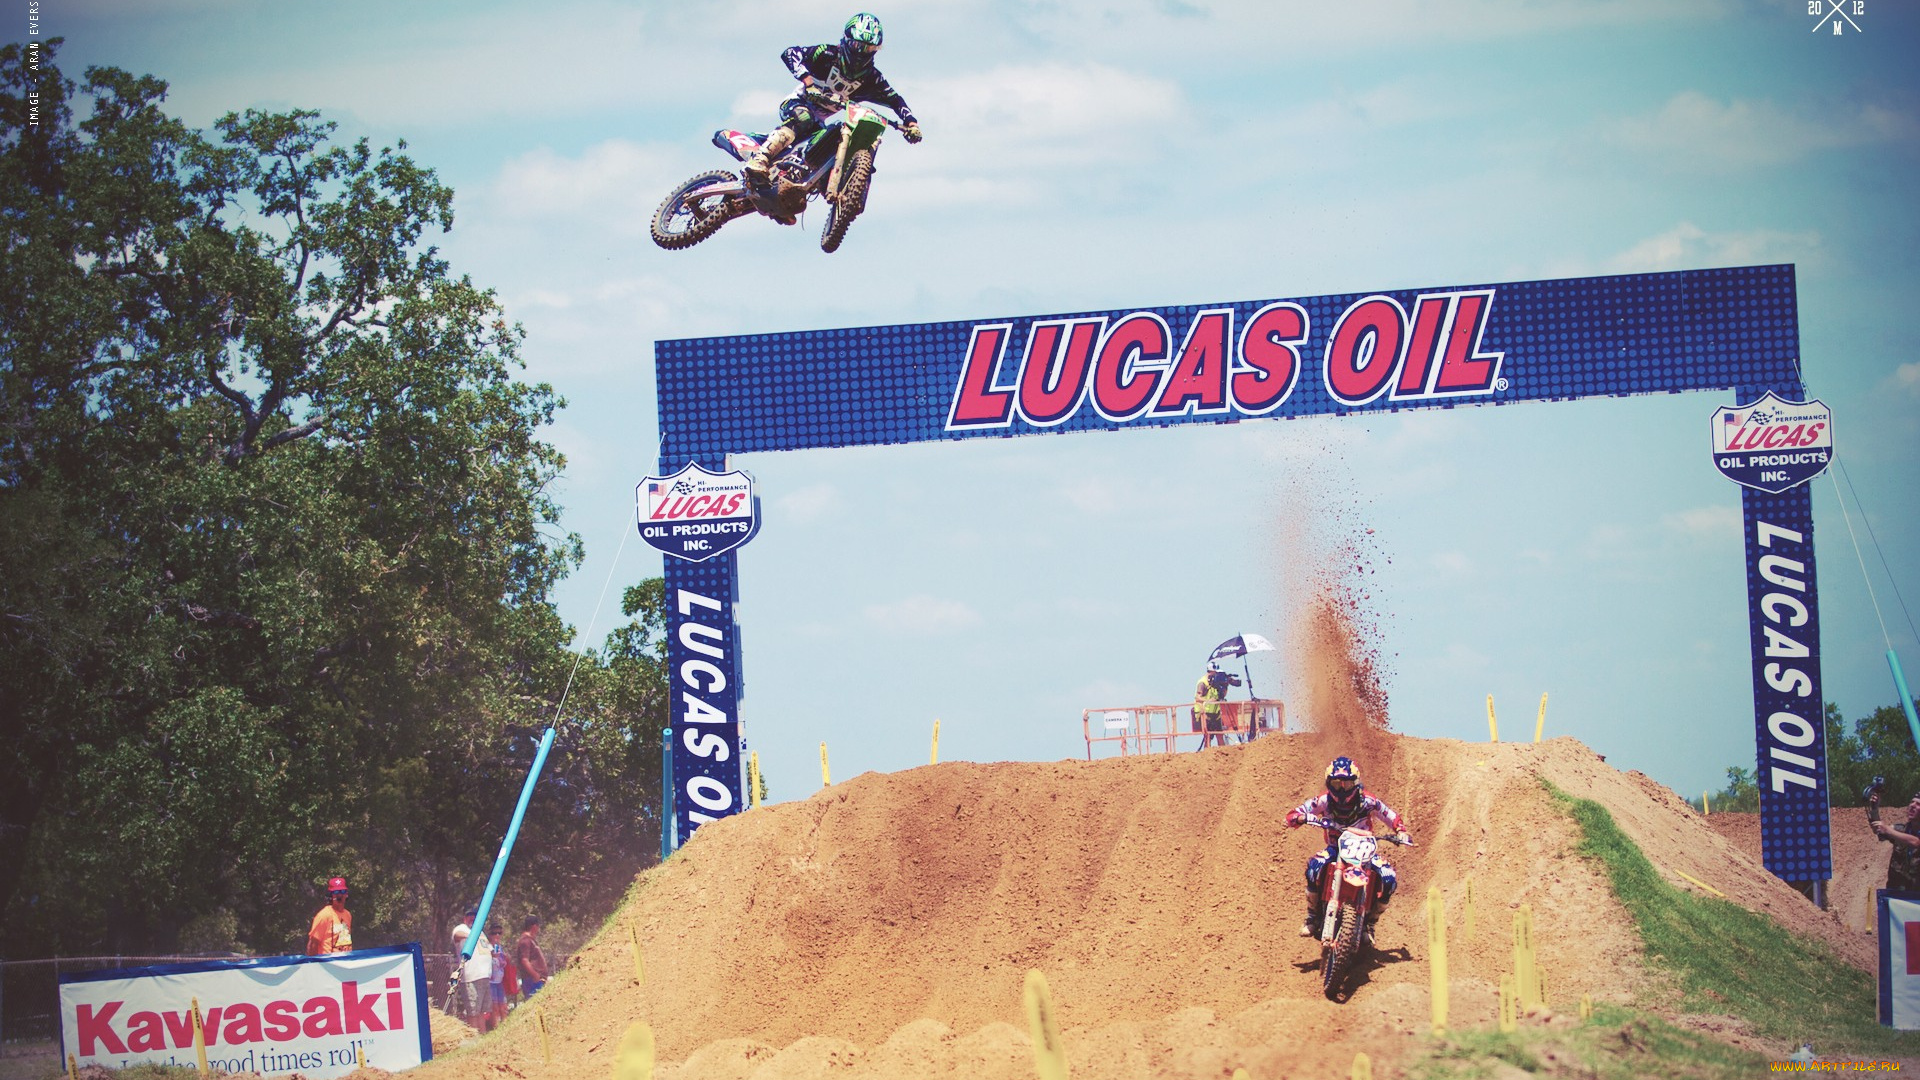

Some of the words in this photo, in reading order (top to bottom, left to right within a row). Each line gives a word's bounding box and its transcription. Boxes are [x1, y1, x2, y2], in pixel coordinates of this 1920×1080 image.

[944, 302, 1310, 431] LUCAS
[1323, 289, 1506, 406] OIL
[1725, 422, 1825, 450] LUCAS
[1719, 457, 1745, 469] OIL
[1750, 452, 1828, 467] PRODUCTS
[1761, 470, 1791, 482] INC.
[649, 493, 746, 520] LUCAS
[644, 527, 668, 538] OIL
[672, 521, 748, 537] PRODUCTS
[683, 540, 713, 551] INC.
[1757, 520, 1813, 697] LUCAS
[678, 589, 730, 762] LUCAS
[1767, 712, 1817, 794] OIL
[76, 977, 405, 1057] Kawasaki
[207, 1049, 254, 1074] ood
[261, 1048, 323, 1073] times
